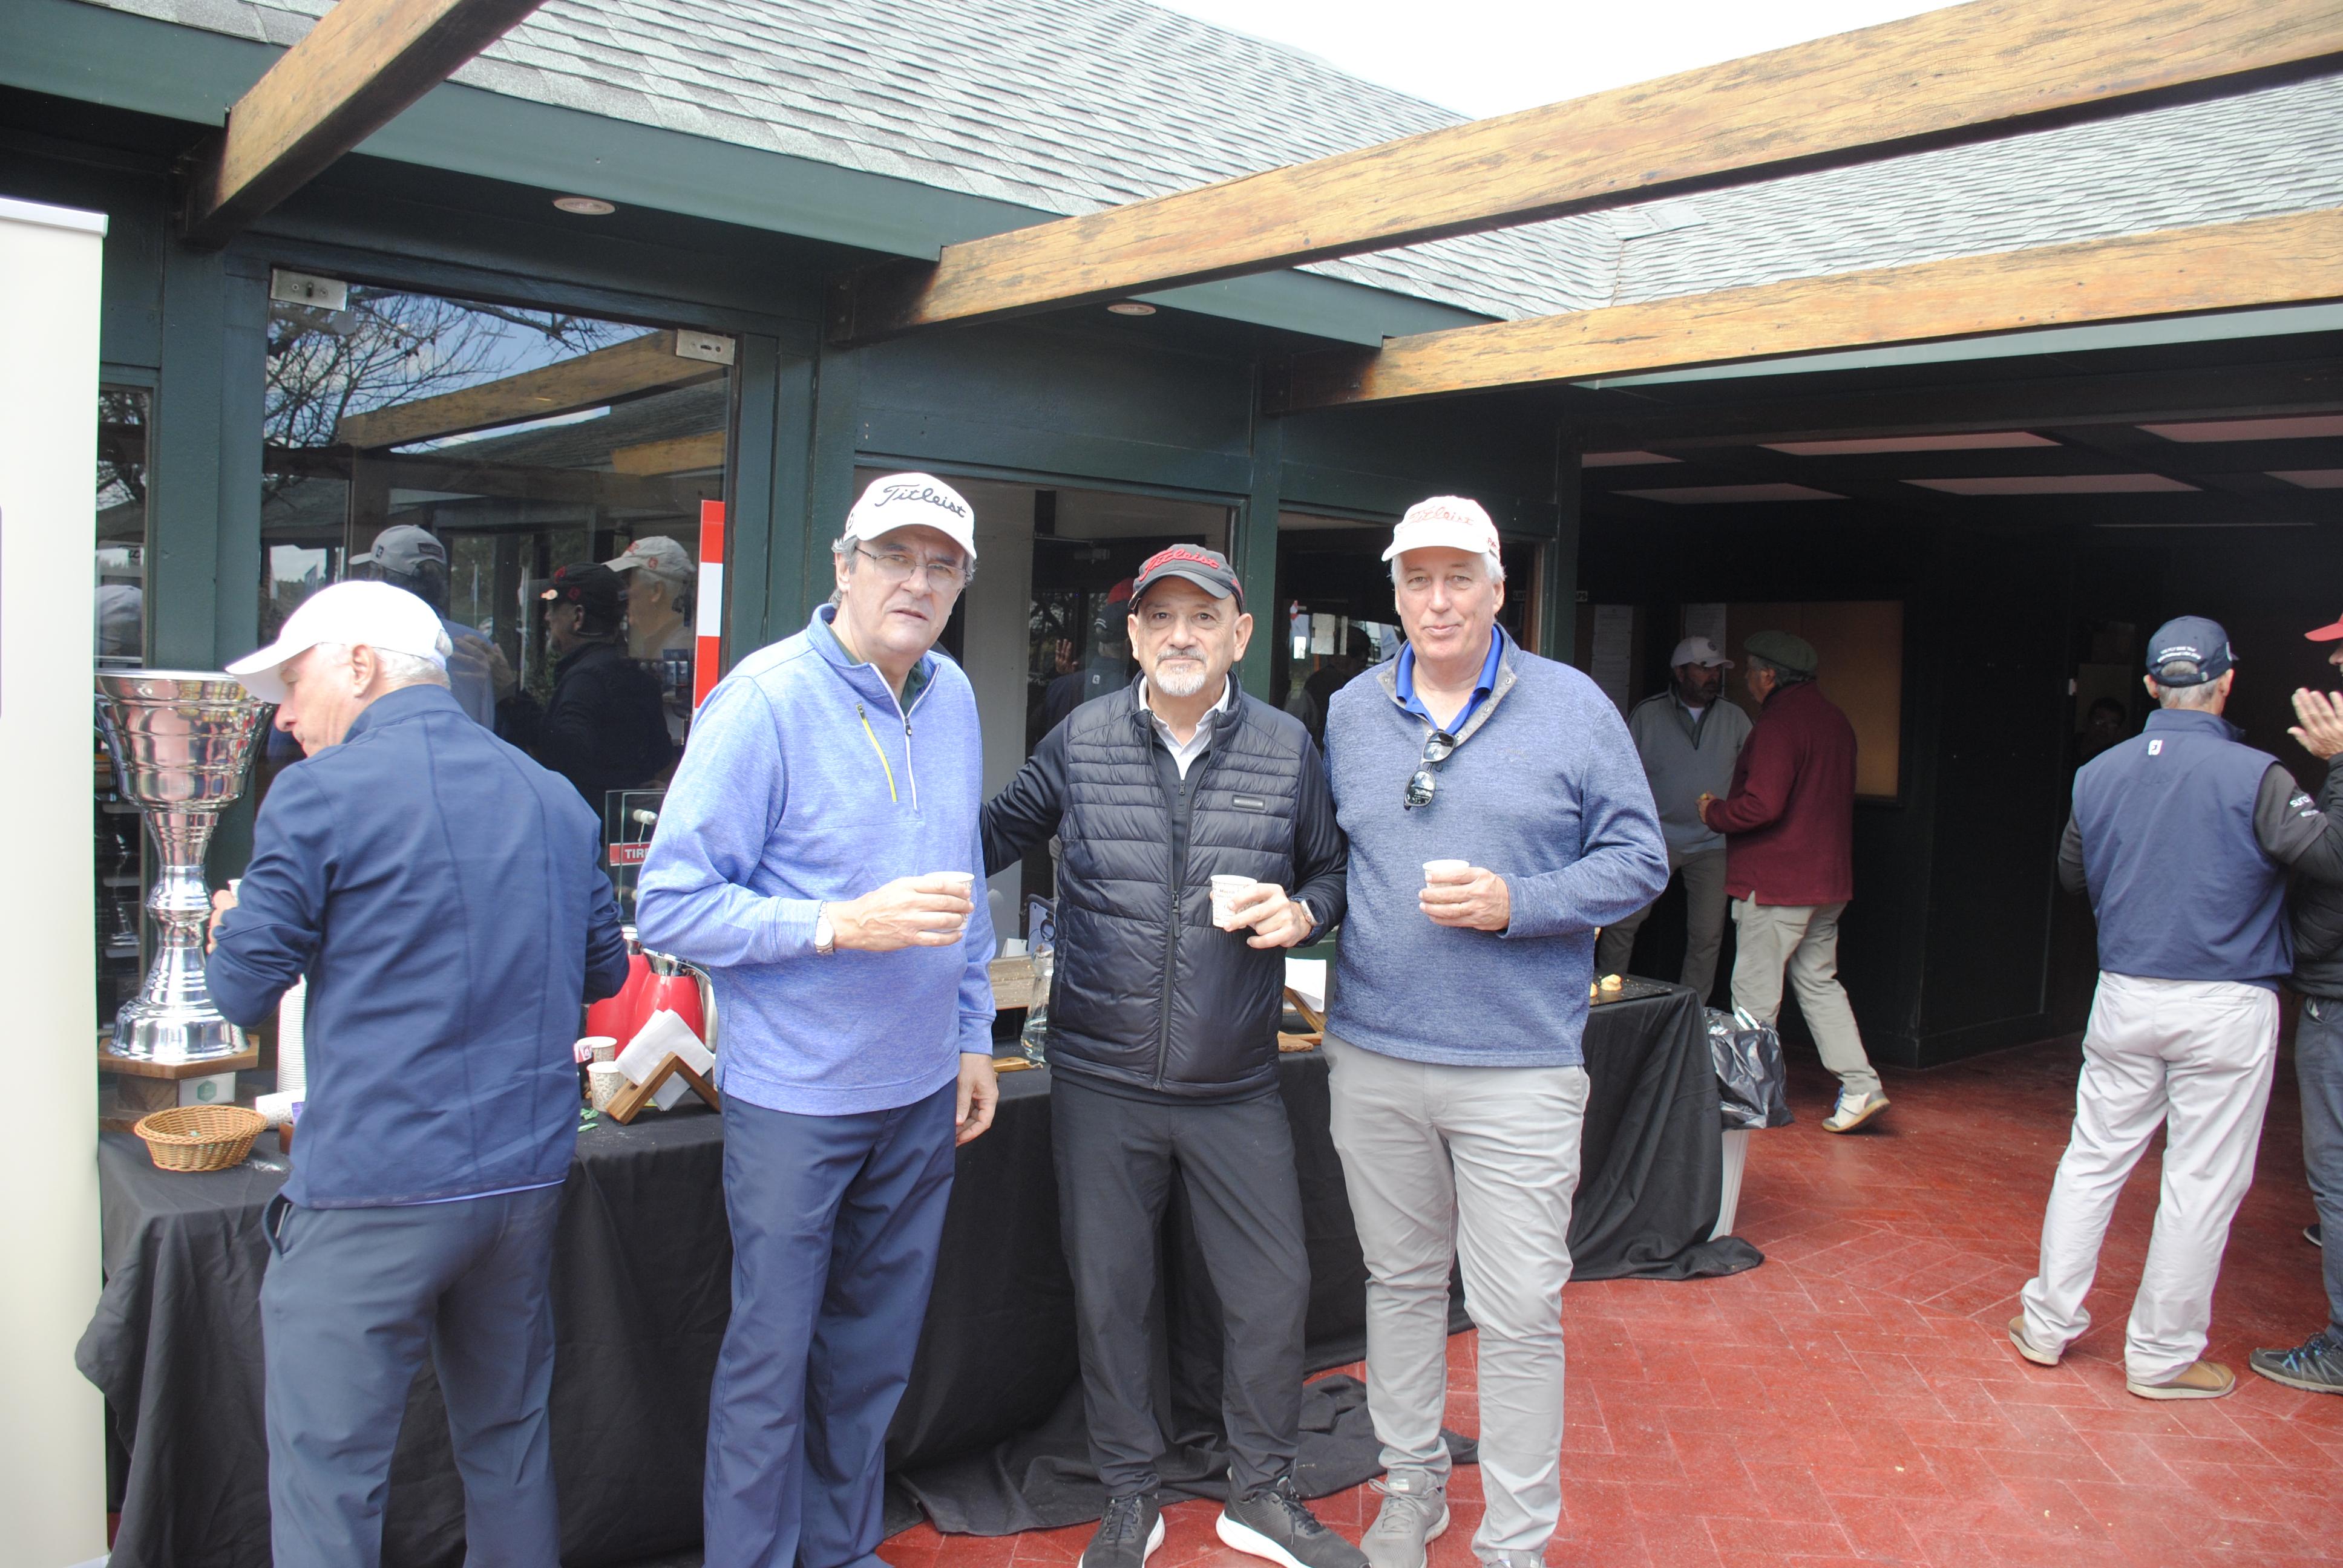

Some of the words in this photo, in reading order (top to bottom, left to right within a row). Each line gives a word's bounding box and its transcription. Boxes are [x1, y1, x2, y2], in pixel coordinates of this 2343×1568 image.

[874, 484, 966, 518] Titleist
[1400, 506, 1475, 529] Titleist
[1139, 548, 1220, 582] Titleist
